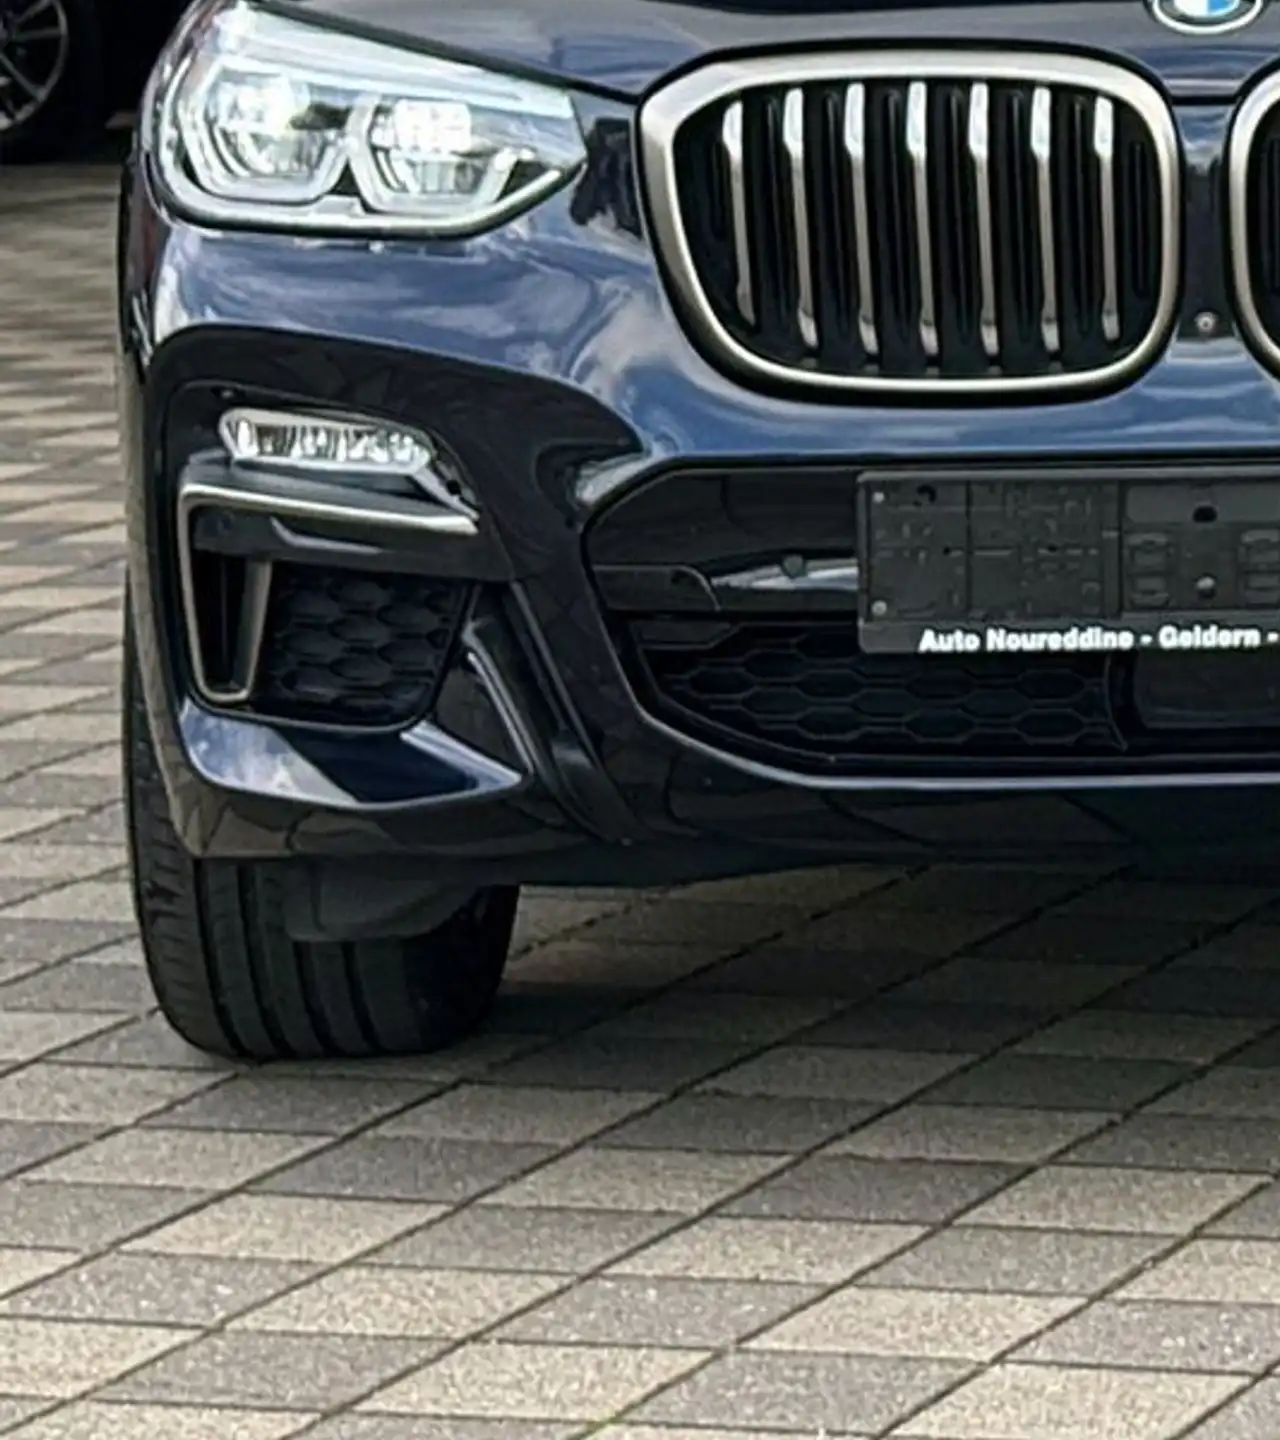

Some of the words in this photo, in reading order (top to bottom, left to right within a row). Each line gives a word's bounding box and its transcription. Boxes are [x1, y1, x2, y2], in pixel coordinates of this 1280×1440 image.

[918, 628, 981, 653] Auto
[986, 627, 1135, 652] Noureddine
[1158, 624, 1262, 649] Geldern
